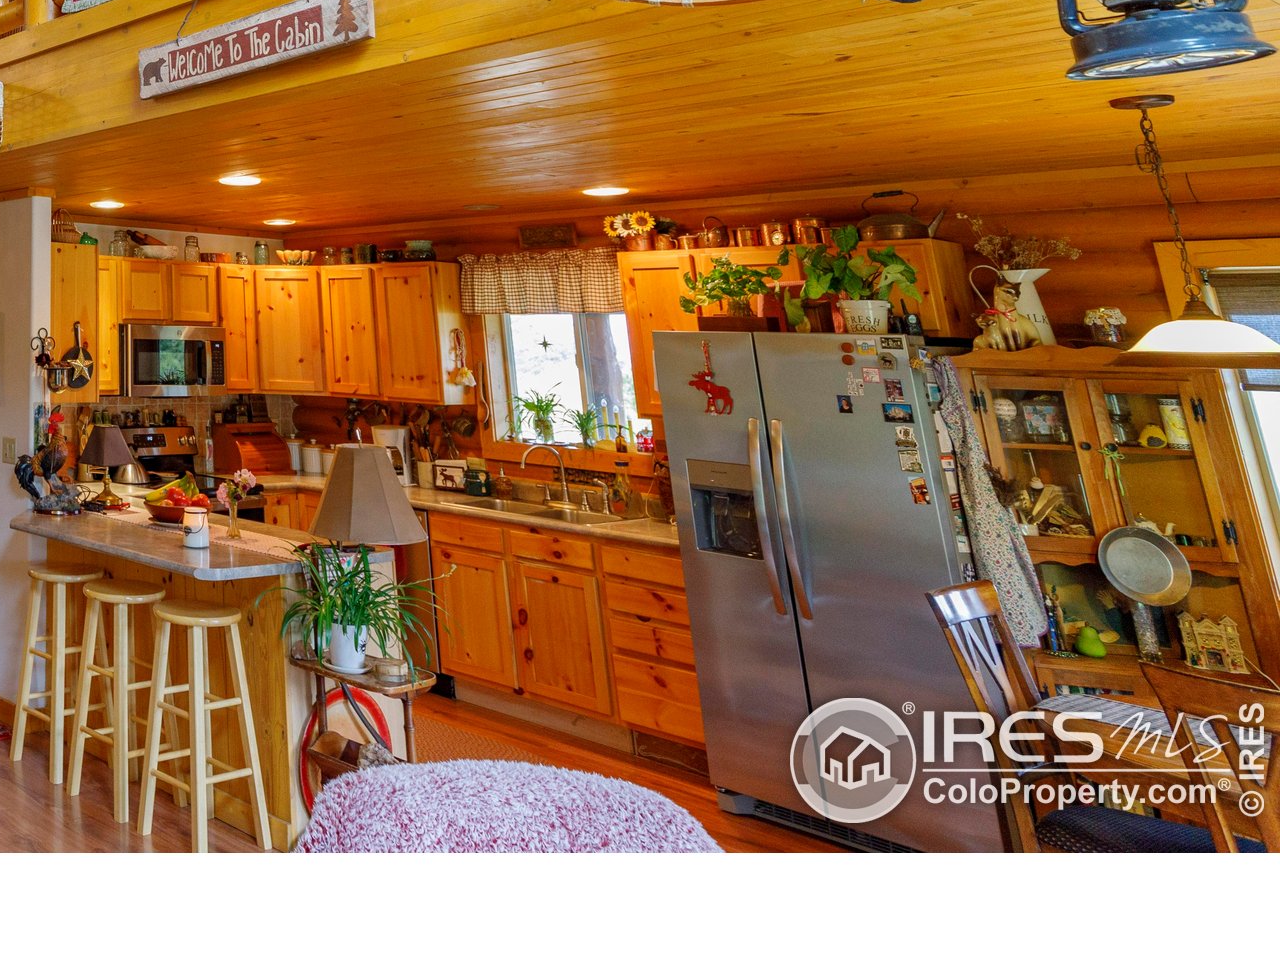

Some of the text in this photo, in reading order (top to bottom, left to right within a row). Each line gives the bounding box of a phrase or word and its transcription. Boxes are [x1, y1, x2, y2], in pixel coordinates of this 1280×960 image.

[225, 33, 242, 64] To
[244, 26, 270, 58] The
[275, 16, 321, 53] Cabin
[846, 315, 880, 327] FRESH
[851, 324, 877, 333] EGGS
